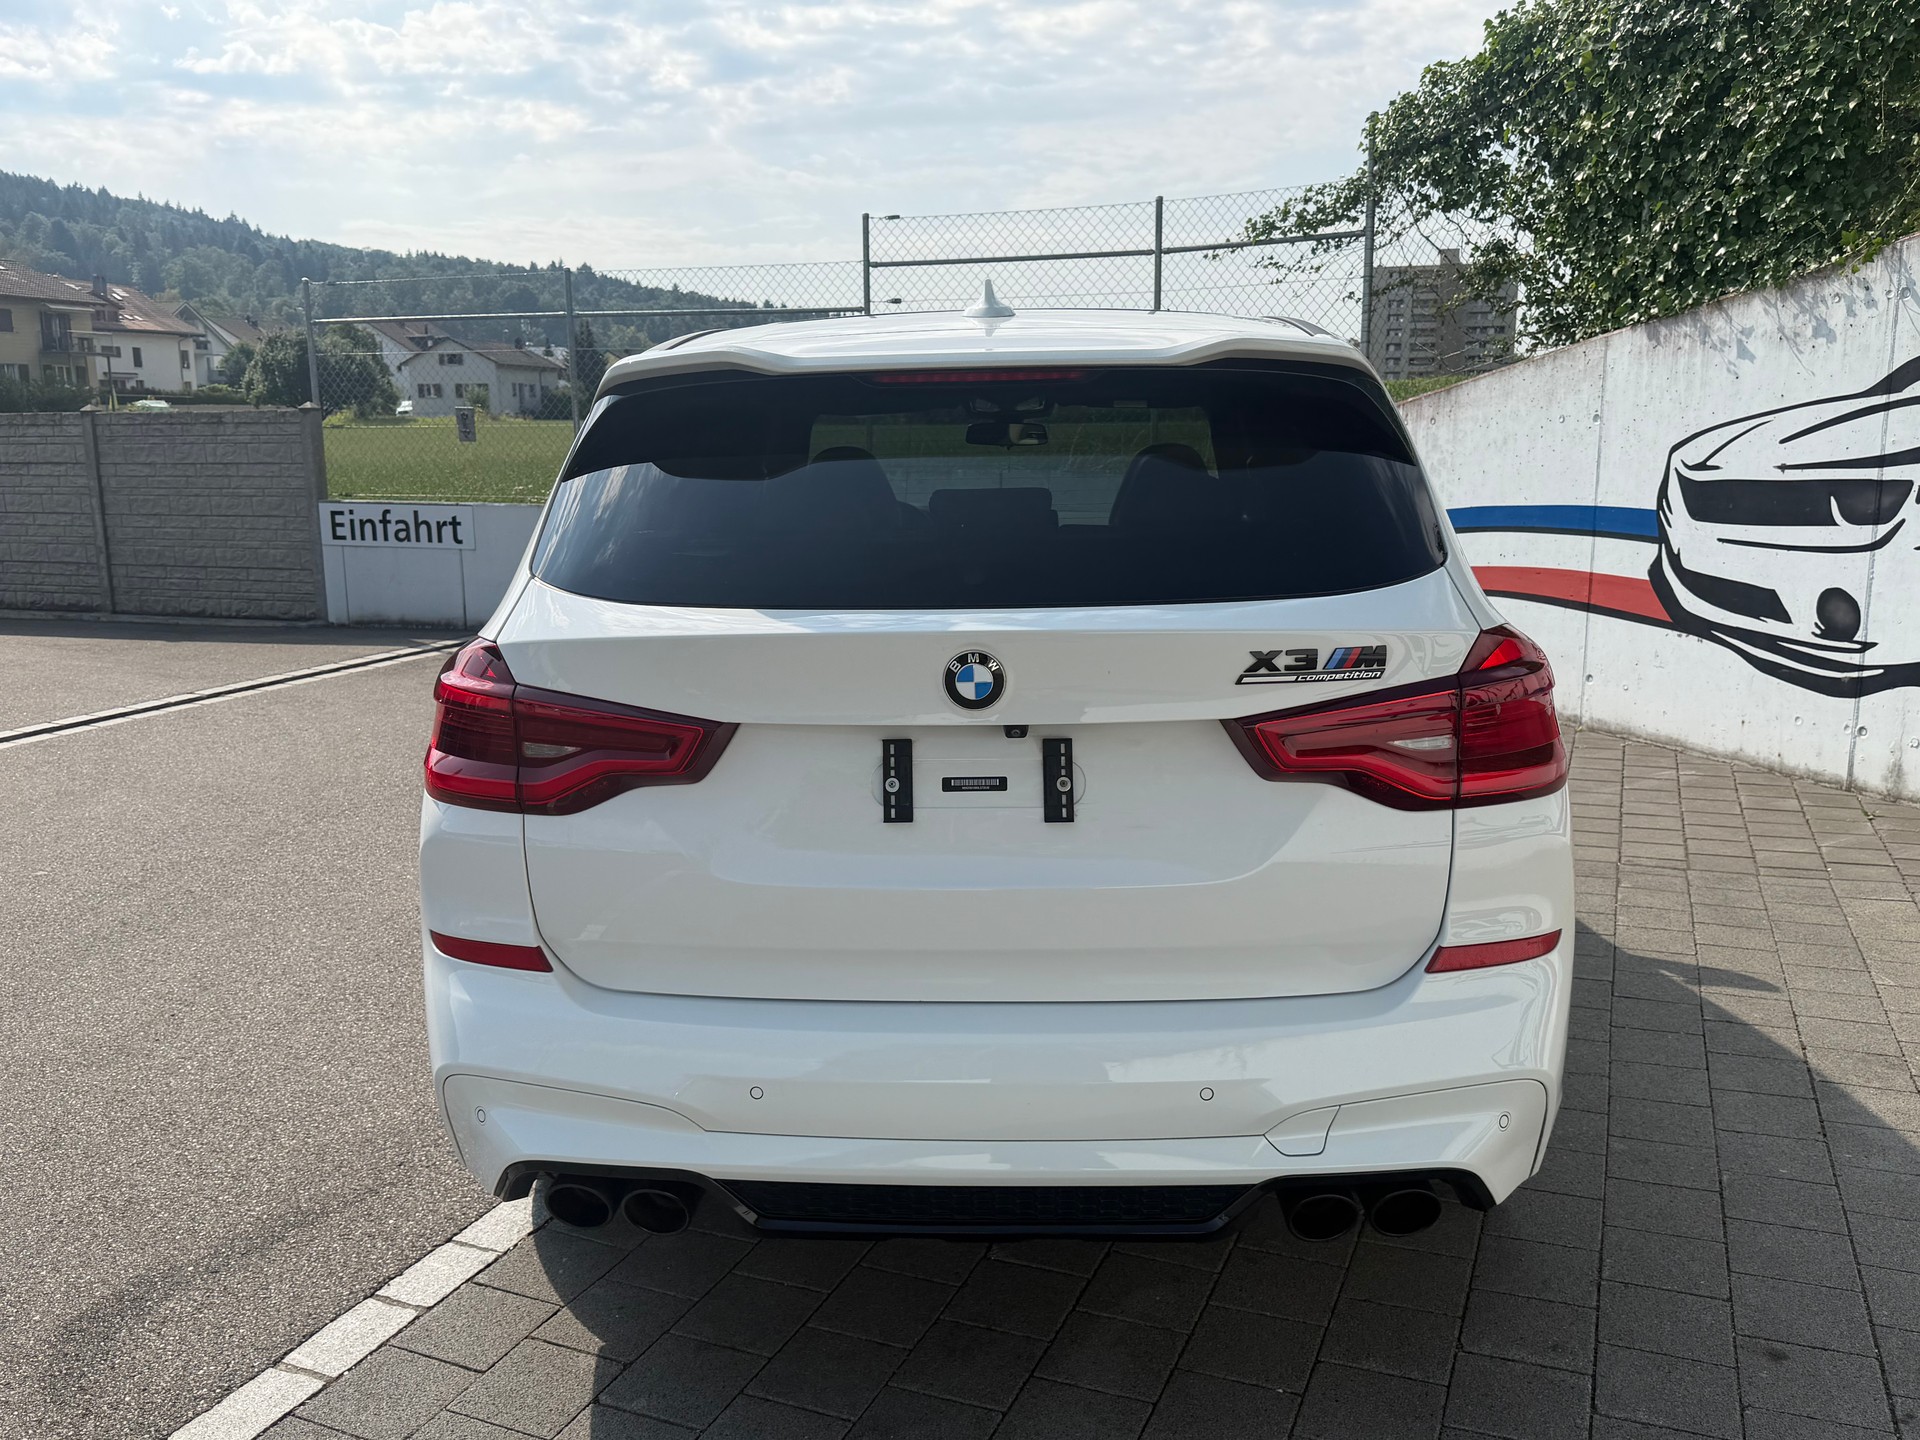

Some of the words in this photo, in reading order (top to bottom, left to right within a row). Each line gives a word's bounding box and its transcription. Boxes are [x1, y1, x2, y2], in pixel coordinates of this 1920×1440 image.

[330, 509, 463, 544] Einfahrt
[949, 653, 1000, 673] BMW
[1297, 671, 1381, 681] competition
